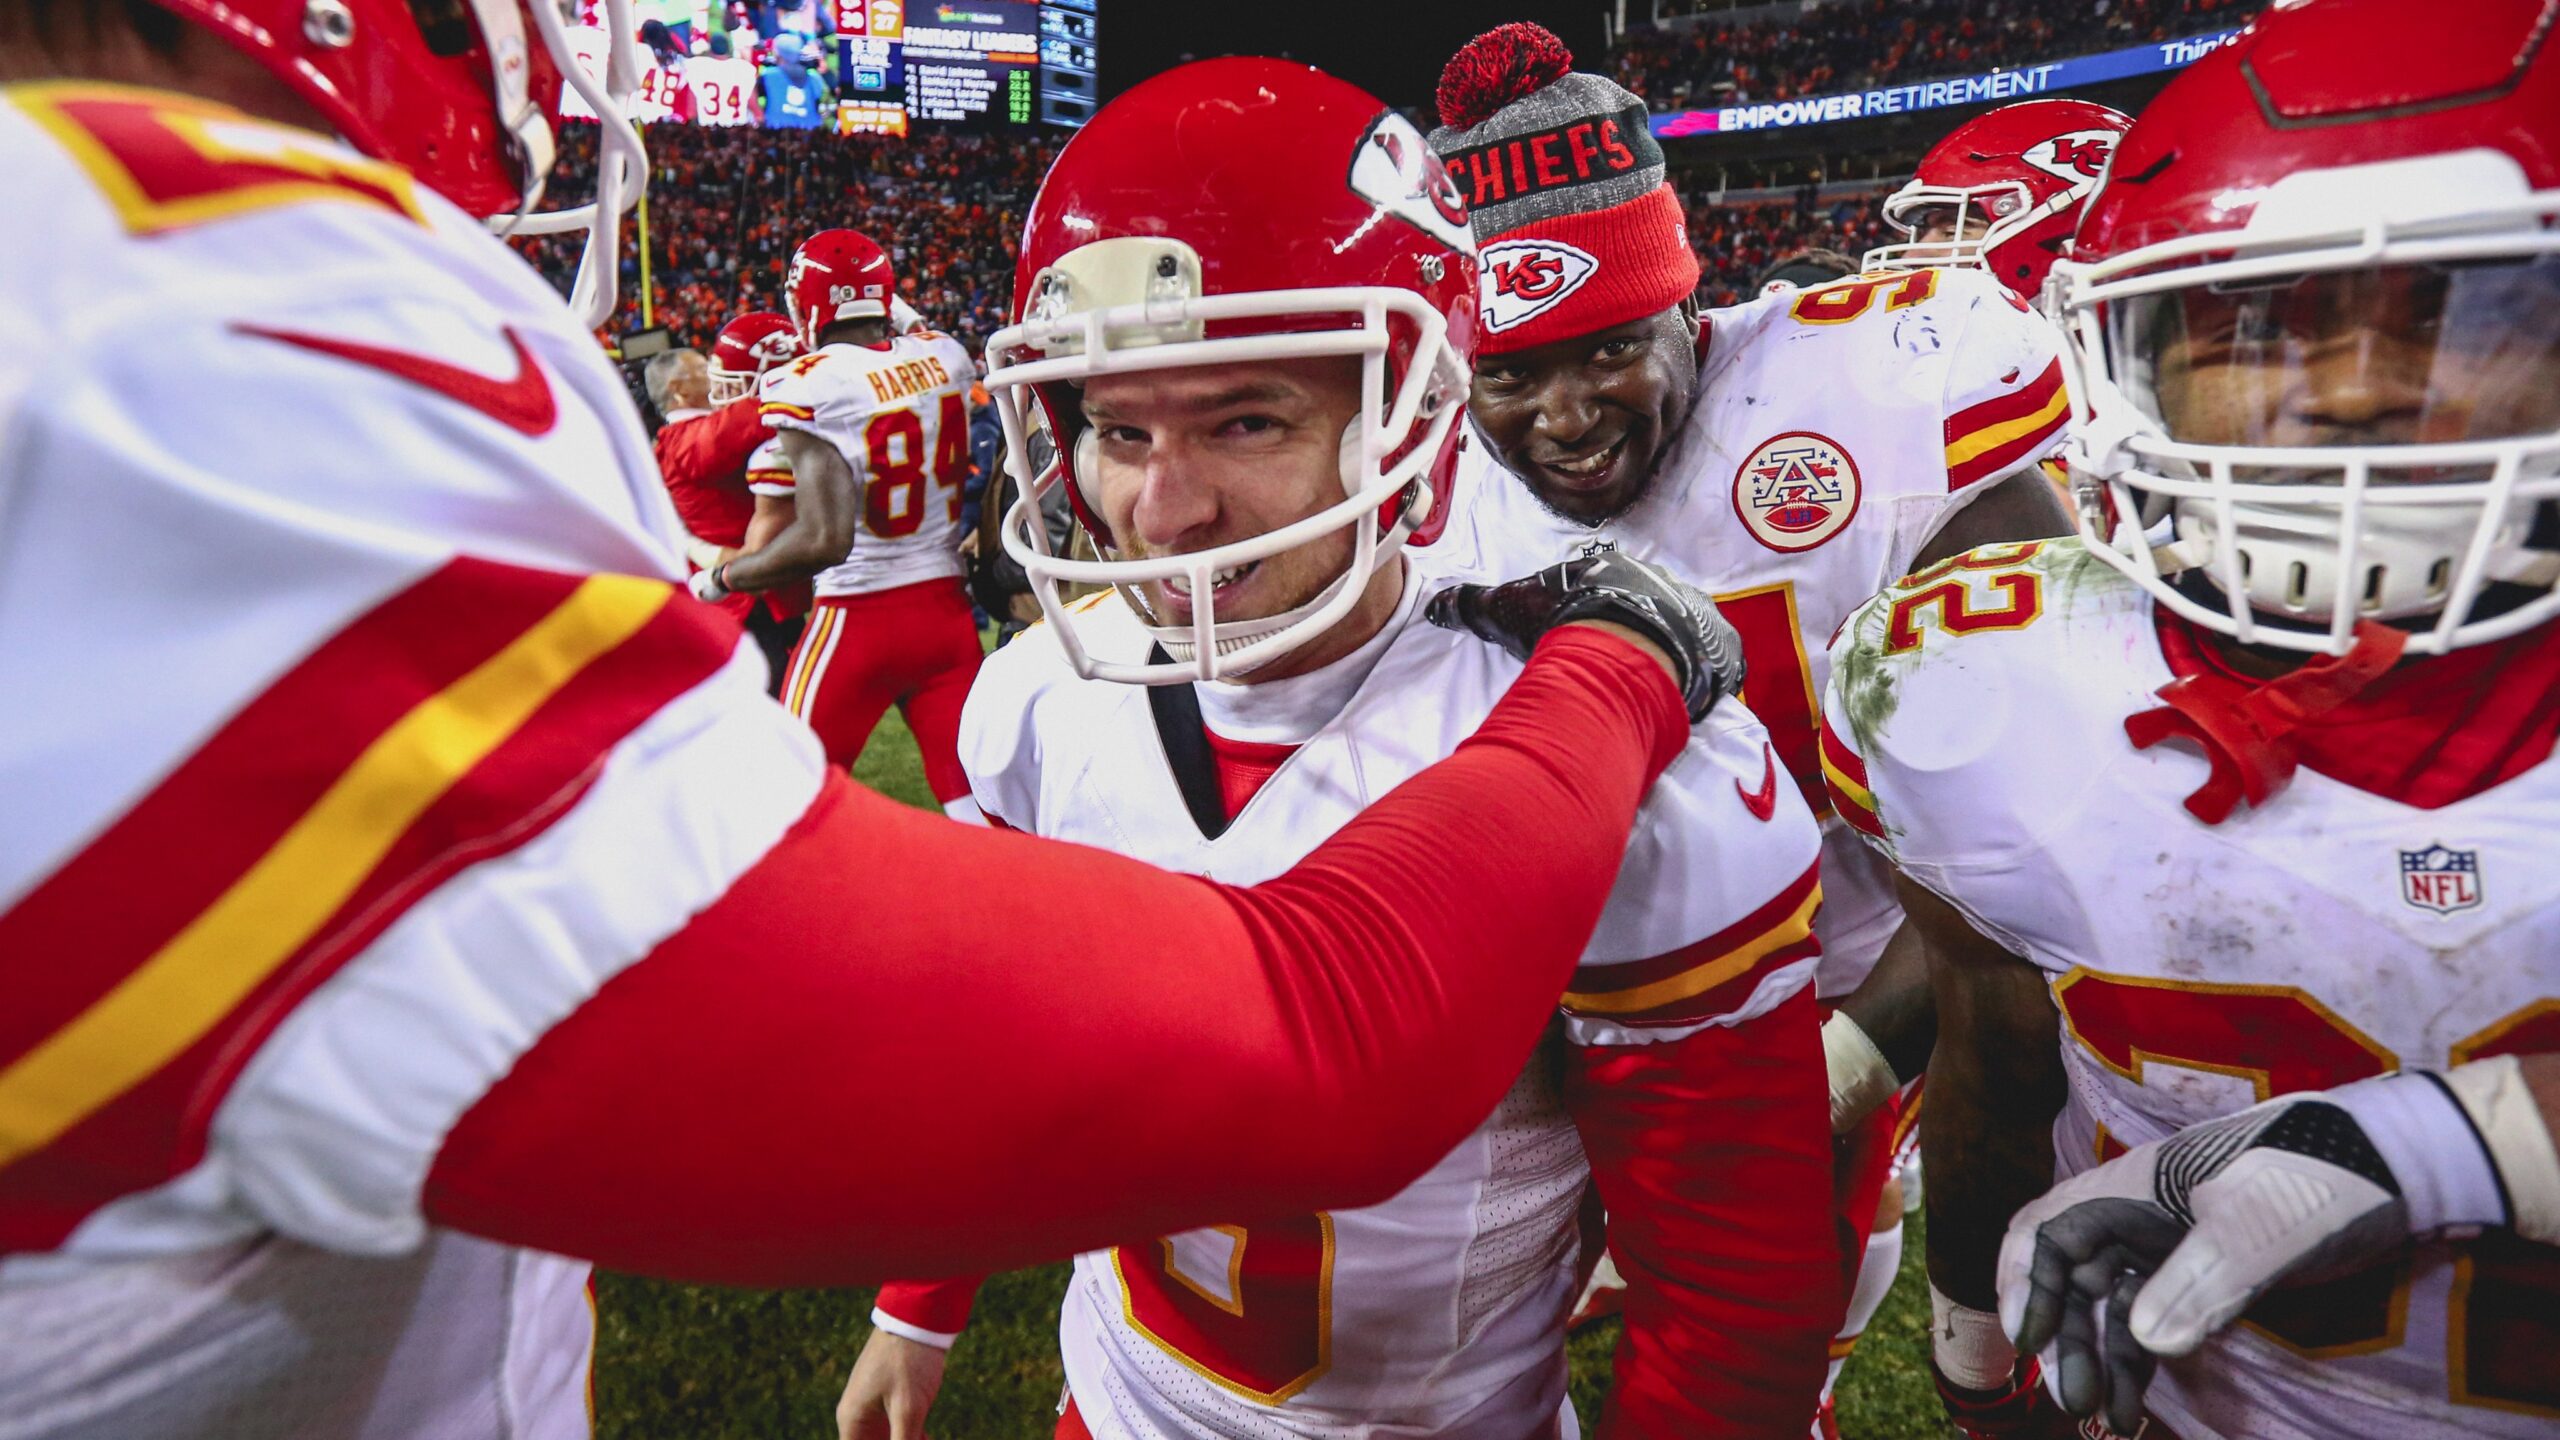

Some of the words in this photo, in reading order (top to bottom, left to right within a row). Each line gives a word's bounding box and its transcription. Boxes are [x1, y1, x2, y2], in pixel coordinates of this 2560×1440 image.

[840, 10, 865, 30] 30
[873, 13, 898, 31] 27
[903, 26, 971, 49] FANTASY
[972, 31, 1038, 53] LEADERS
[702, 81, 742, 118] 34
[1718, 94, 1864, 132] EMPOWER
[1863, 64, 2055, 116] RETIREMENT
[1446, 120, 1636, 205] CHIEFS
[1491, 252, 1565, 301] KC
[866, 356, 949, 402] HARRIS
[861, 389, 971, 541] 84
[2409, 873, 2475, 907] NFL
